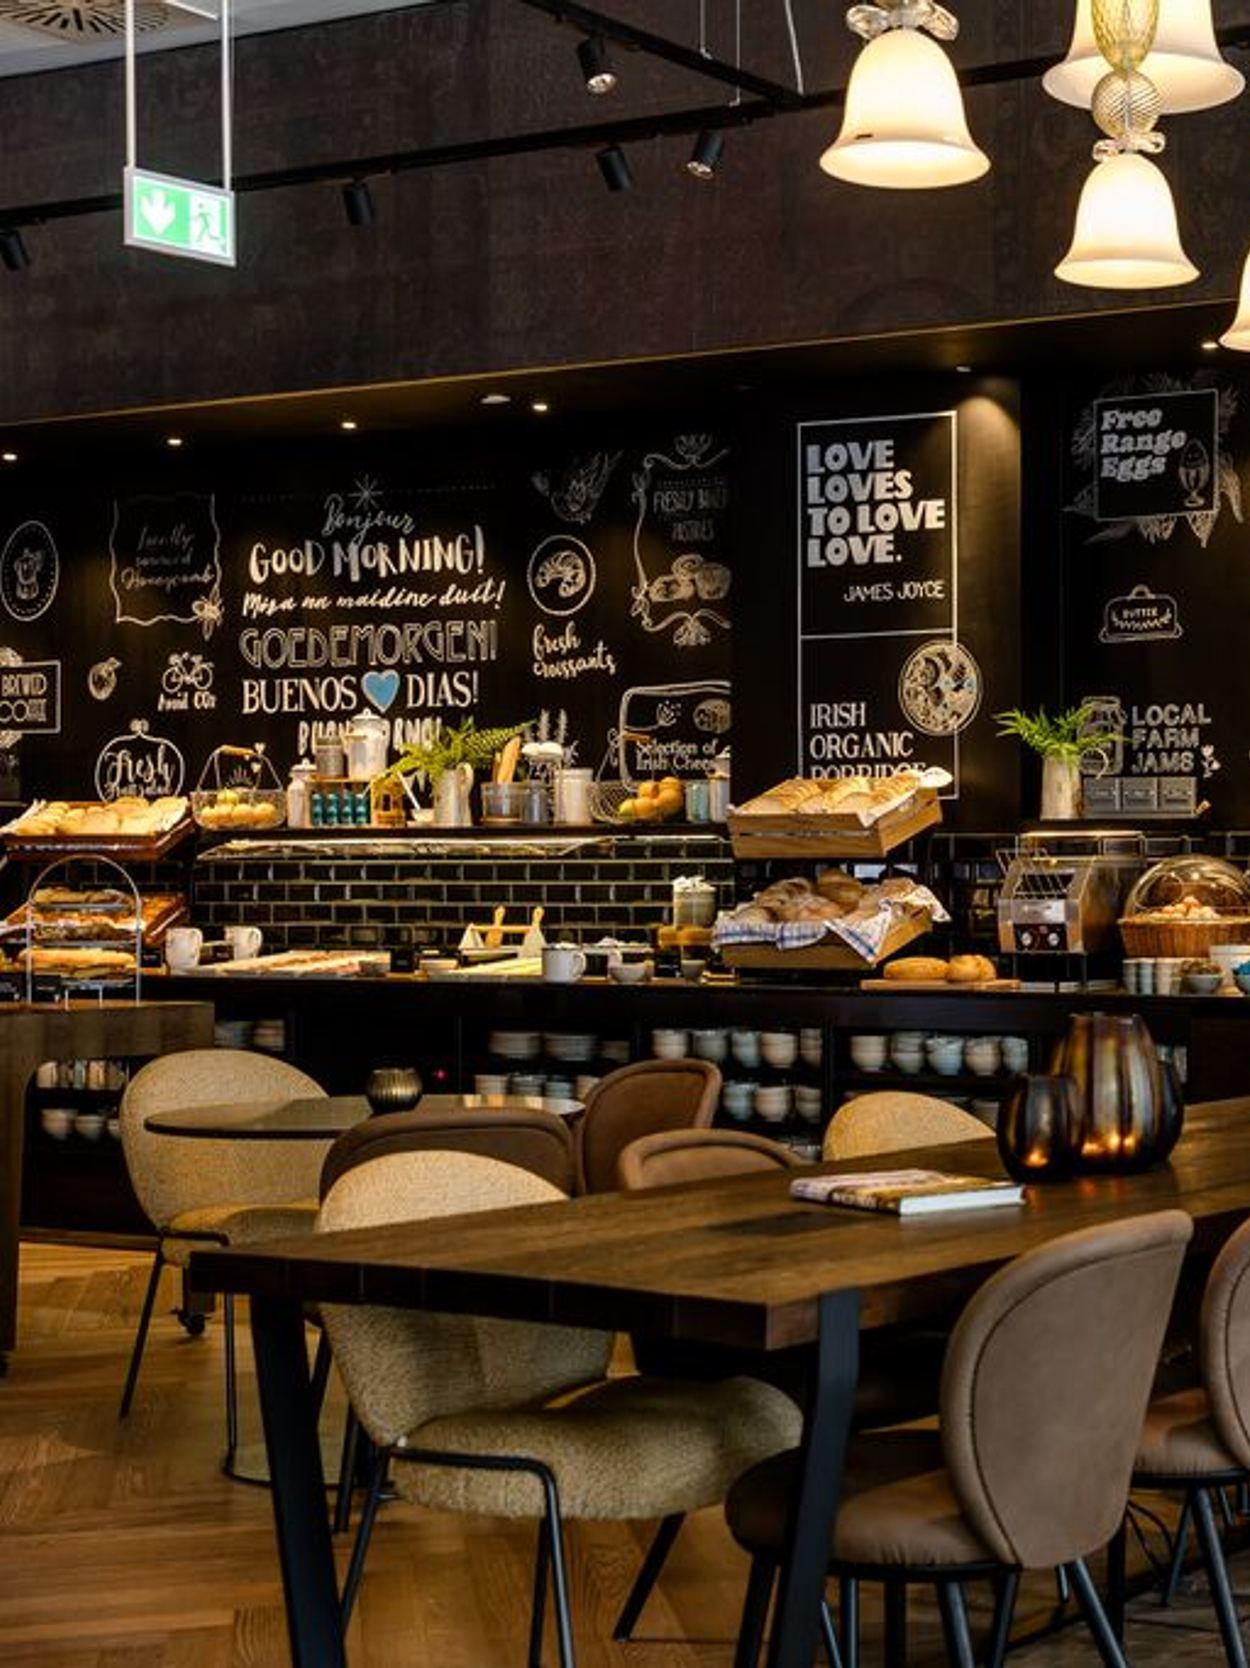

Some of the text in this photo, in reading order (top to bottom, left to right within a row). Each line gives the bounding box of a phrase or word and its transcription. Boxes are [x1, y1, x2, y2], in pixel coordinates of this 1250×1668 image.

[1100, 407, 1163, 431] Free
[1100, 428, 1187, 455] Range
[806, 440, 895, 474] LOVE
[1100, 454, 1167, 483] Eggs
[806, 470, 913, 505] LOVES
[321, 492, 417, 546] Bonjour
[808, 499, 945, 537] TO LOVE
[806, 534, 902, 568] LOVE.
[844, 580, 945, 603] JAMES JOYCE
[533, 640, 619, 680] croissants
[241, 670, 479, 715] BUENOS DIAS!
[810, 701, 867, 729] IRISH
[1132, 703, 1212, 726] LOCAL
[702, 738, 719, 755] of
[810, 731, 914, 760] ORGANIC
[1132, 727, 1200, 750] FARM
[1131, 751, 1195, 774] JAMS
